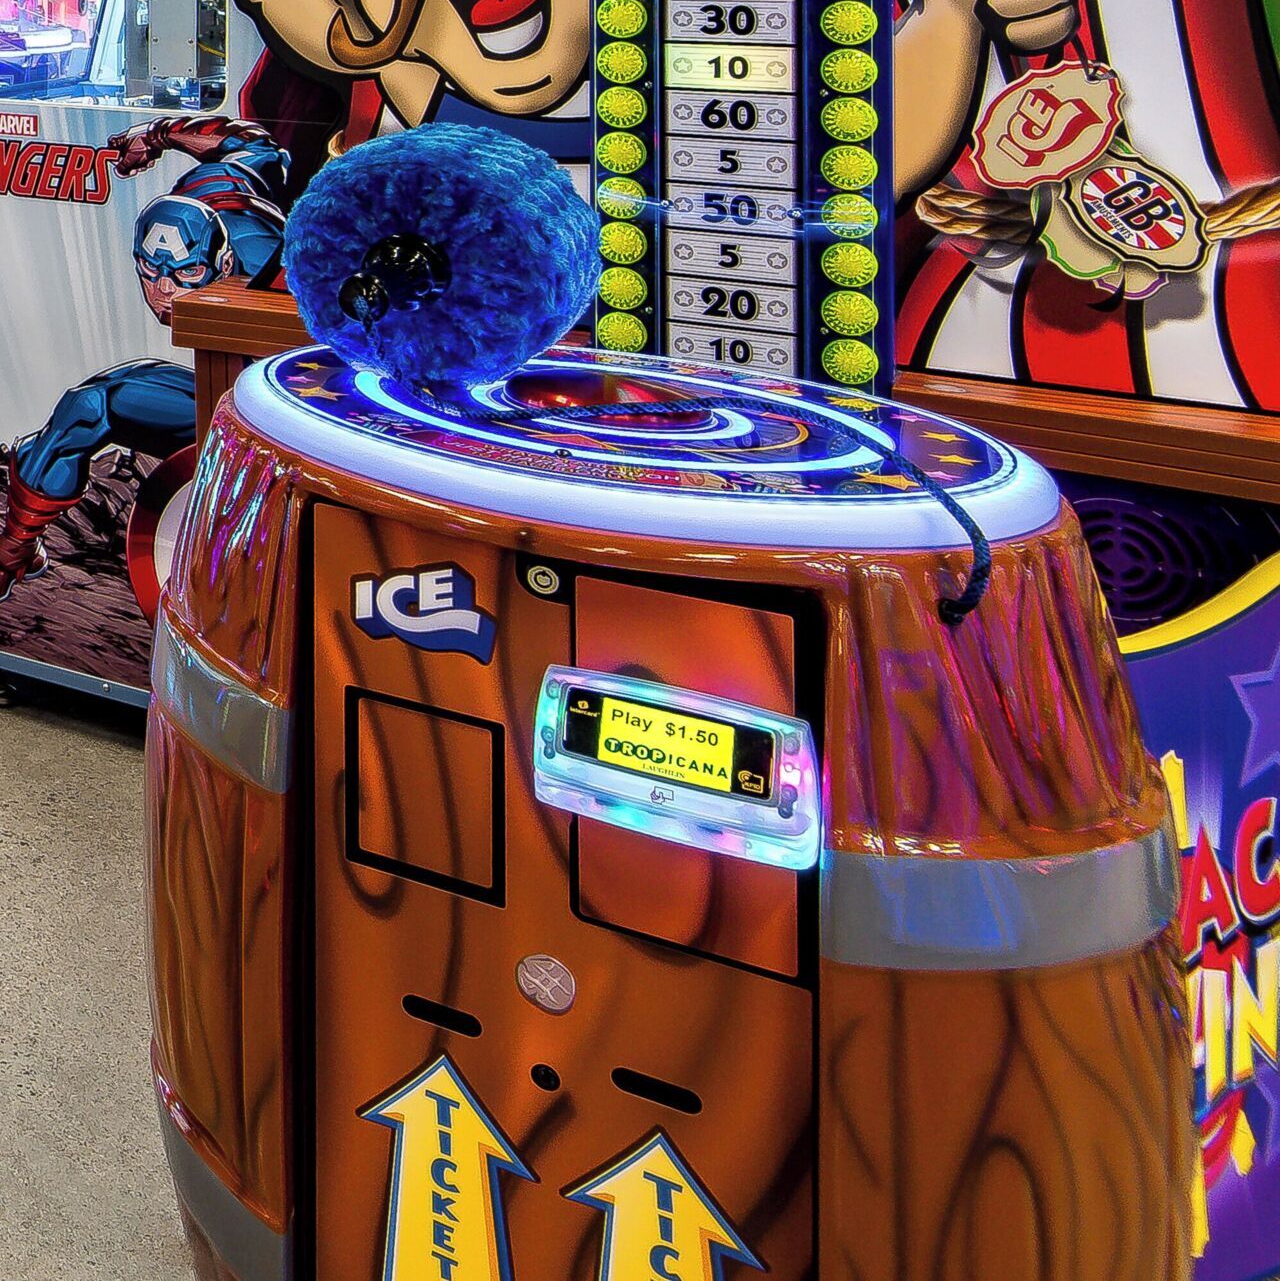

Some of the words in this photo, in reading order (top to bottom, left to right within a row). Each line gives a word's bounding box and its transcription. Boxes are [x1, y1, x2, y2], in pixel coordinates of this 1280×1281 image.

[700, 5, 757, 35] 30
[707, 56, 750, 79] 10
[701, 100, 757, 131] 60
[995, 85, 1105, 168] ICE
[718, 150, 741, 173] 5
[702, 193, 757, 225] 50
[1088, 199, 1136, 241] AMUSEMENTS
[1102, 179, 1173, 232] GB
[718, 244, 741, 268] 5
[702, 287, 758, 318] 20
[709, 339, 752, 364] 10
[353, 565, 486, 640] ICE
[612, 708, 653, 733] Play
[665, 722, 719, 747] $1.50
[605, 737, 729, 780] TROPICANA
[642, 763, 686, 779] LAUGHLIN
